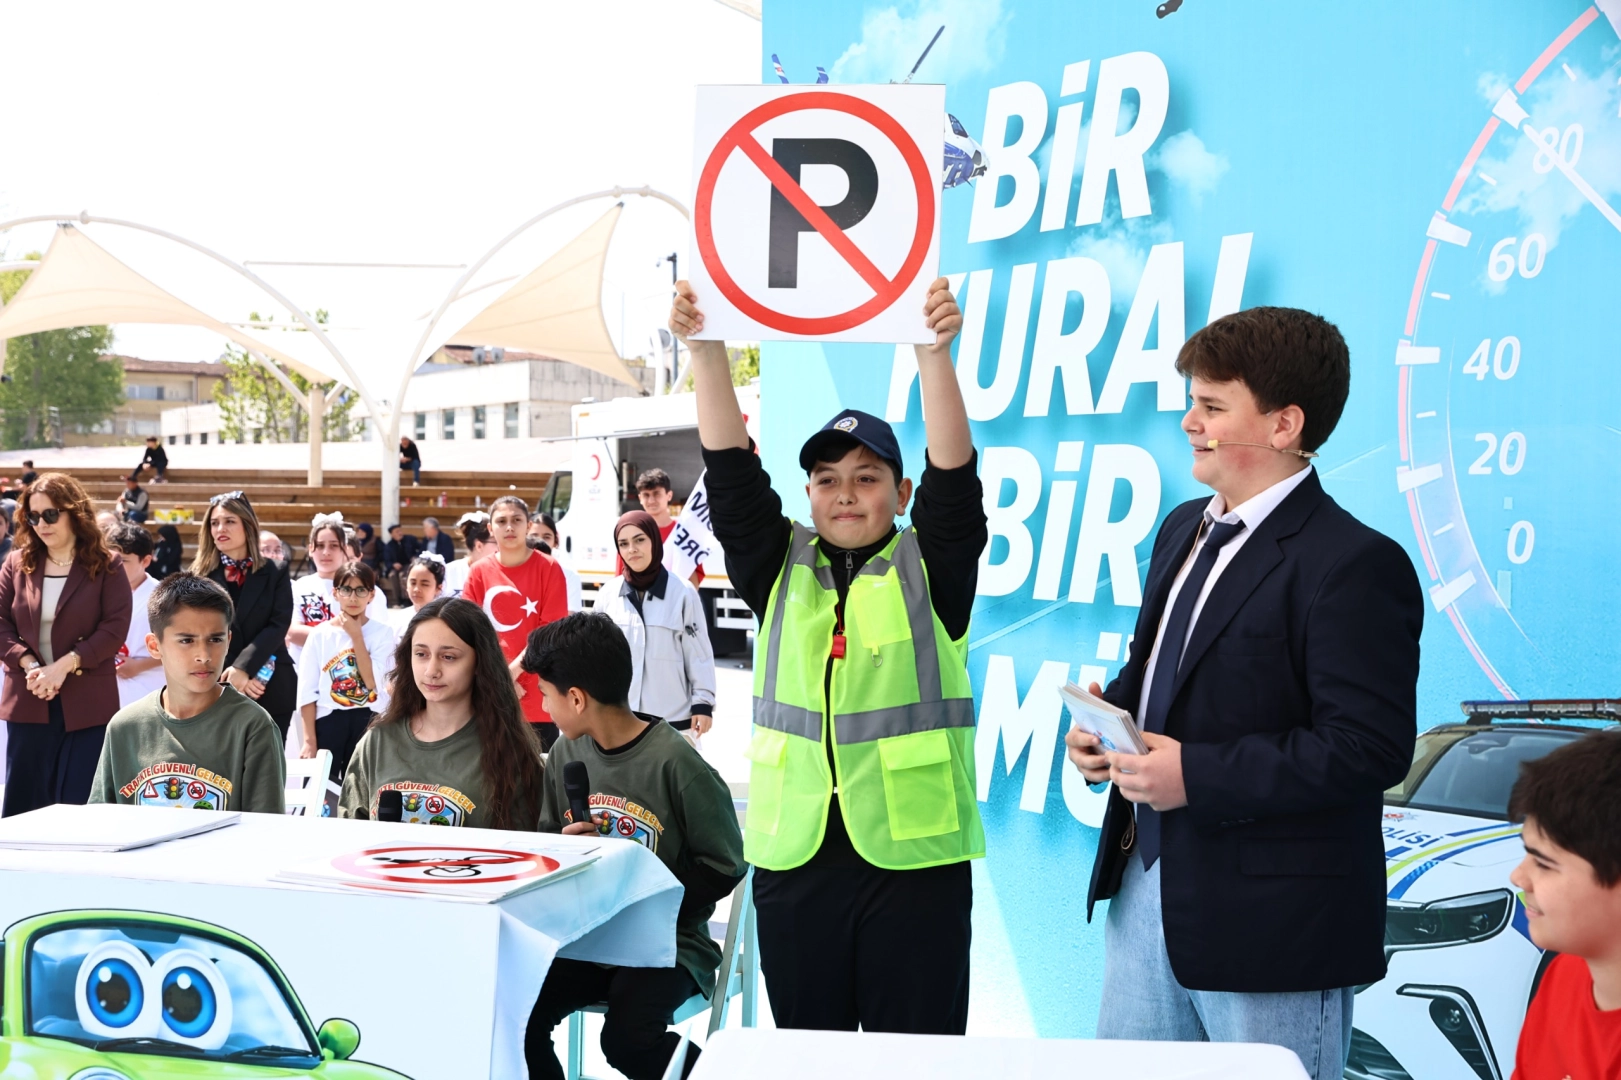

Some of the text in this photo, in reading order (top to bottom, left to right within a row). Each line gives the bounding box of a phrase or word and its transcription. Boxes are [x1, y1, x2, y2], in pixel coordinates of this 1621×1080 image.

[1533, 123, 1583, 174] 80
[768, 138, 878, 288] P
[1488, 233, 1547, 282] 60
[1463, 336, 1521, 380] 40
[1468, 432, 1527, 475] 20
[1506, 520, 1535, 564] 0
[152, 761, 196, 775] GÜVENLİ
[395, 781, 476, 815] GÜVENLİ GELECEK
[588, 792, 627, 809] GÜVENLİ
